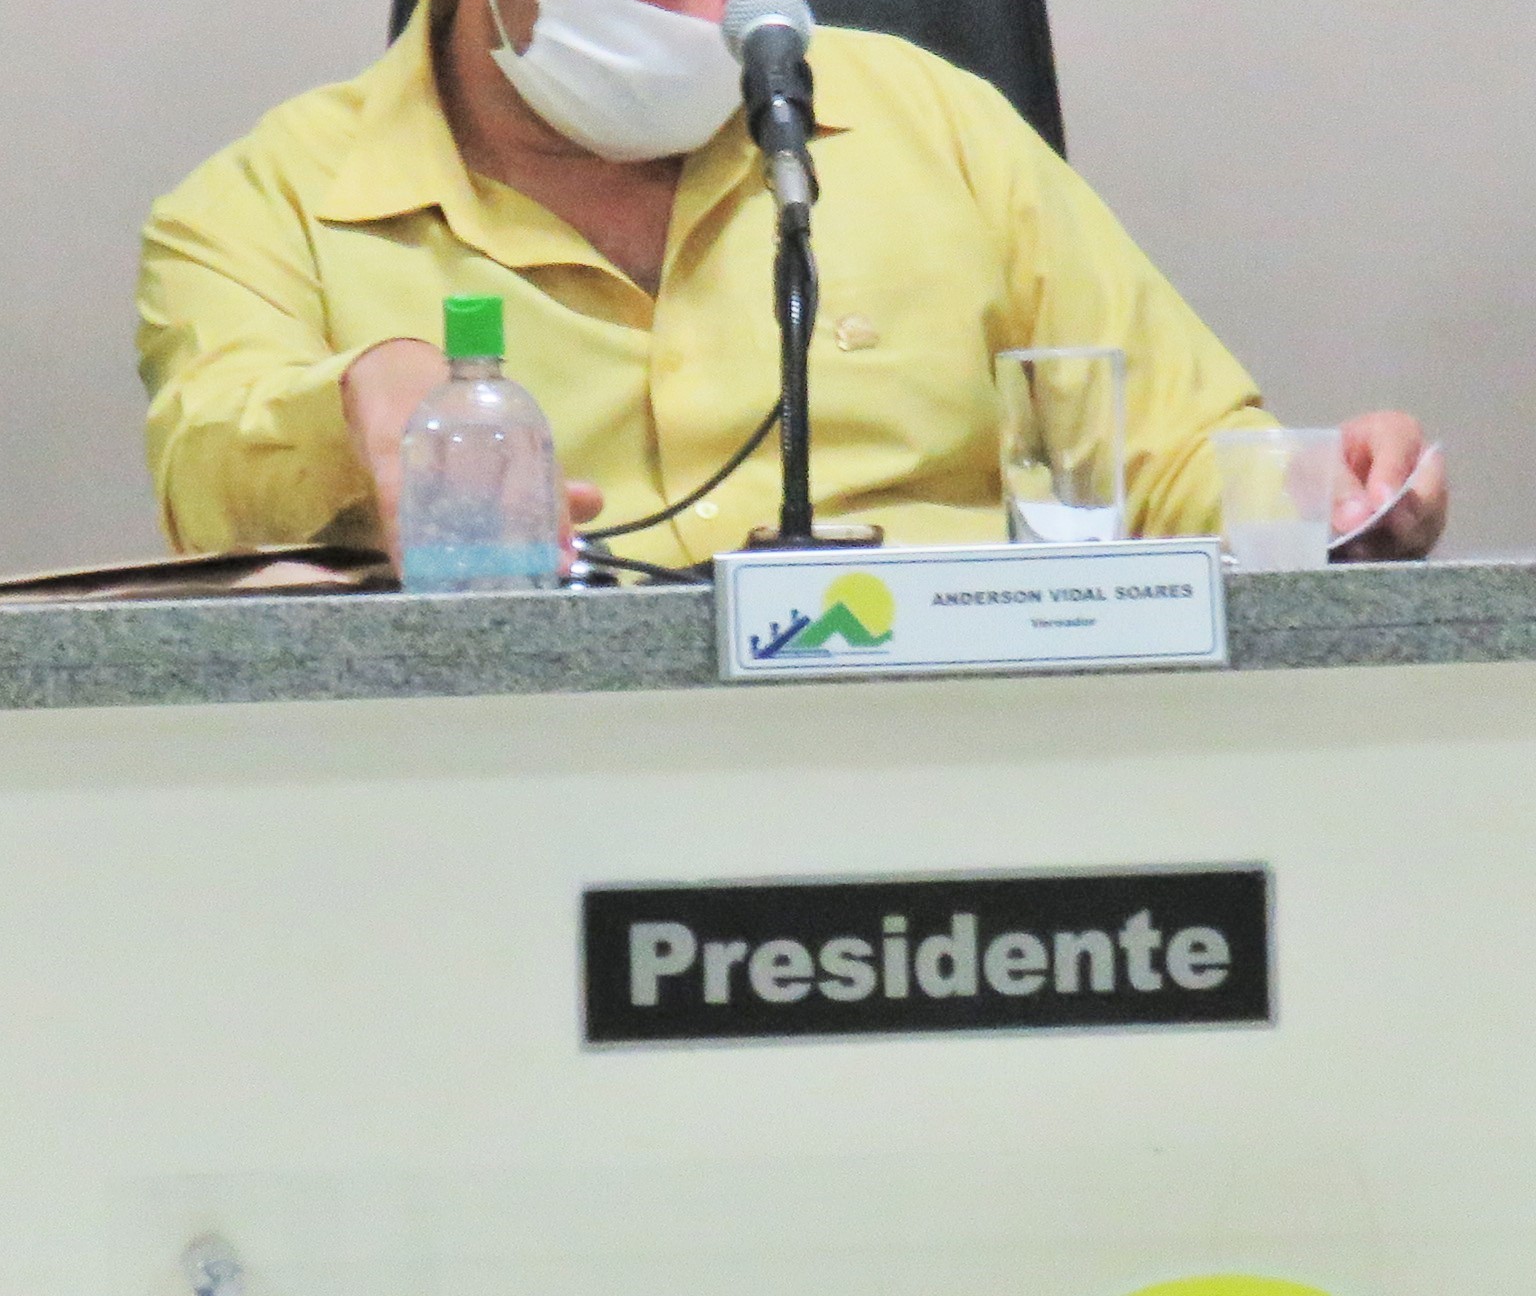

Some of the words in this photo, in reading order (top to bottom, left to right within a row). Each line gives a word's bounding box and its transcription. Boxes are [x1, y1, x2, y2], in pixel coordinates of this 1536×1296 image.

[931, 588, 1043, 607] ANDERSON
[1048, 586, 1107, 604] VIDAL
[1114, 583, 1194, 601] SOARES
[628, 907, 1233, 1006] Presidente
